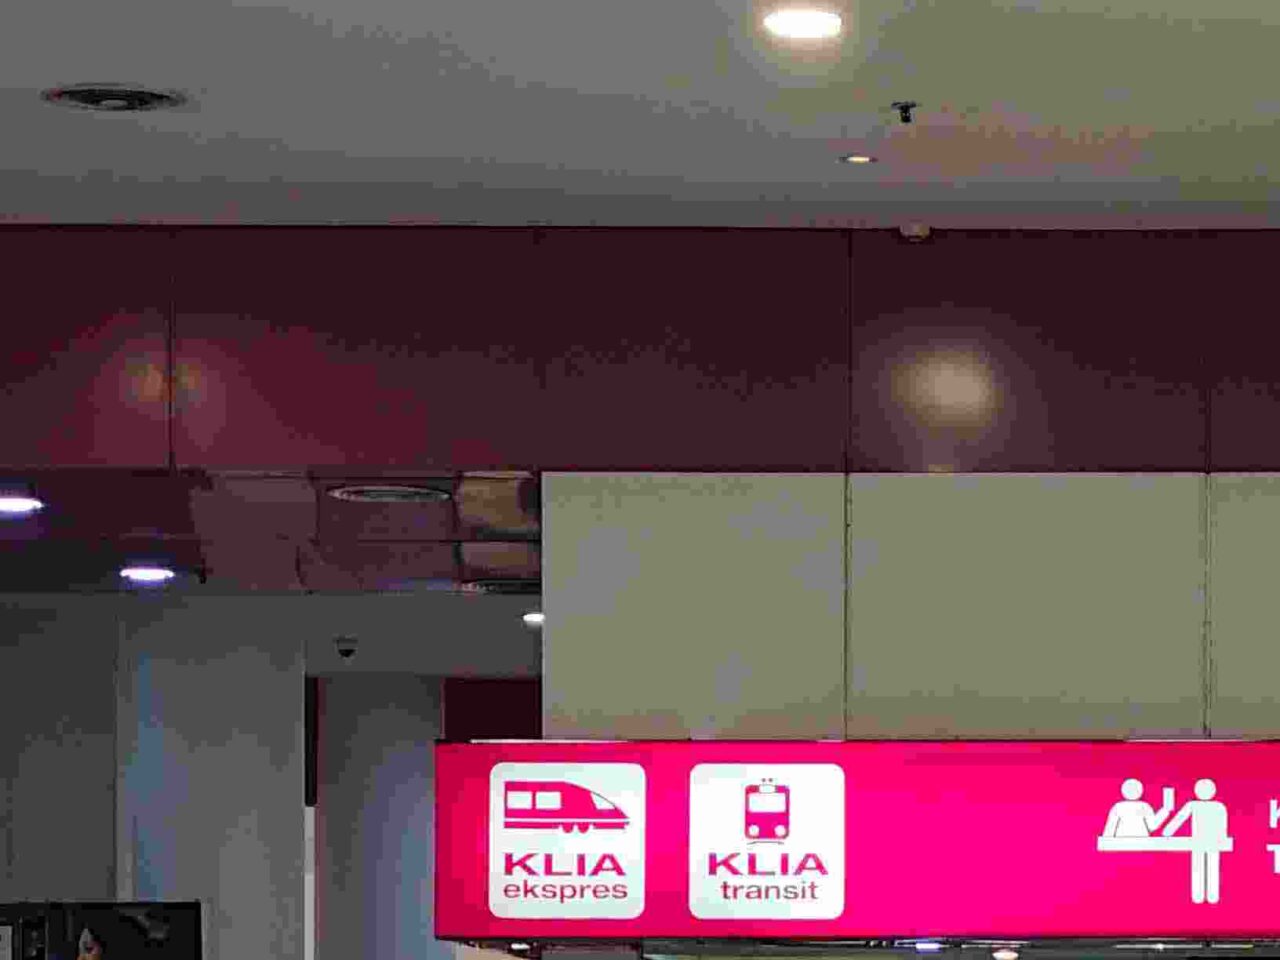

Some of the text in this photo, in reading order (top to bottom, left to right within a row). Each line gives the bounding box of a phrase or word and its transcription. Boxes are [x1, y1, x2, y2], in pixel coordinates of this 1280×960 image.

[503, 853, 626, 876] KLIA
[708, 853, 828, 876] KLIA
[503, 879, 628, 903] ekspres
[720, 879, 818, 900] transit
